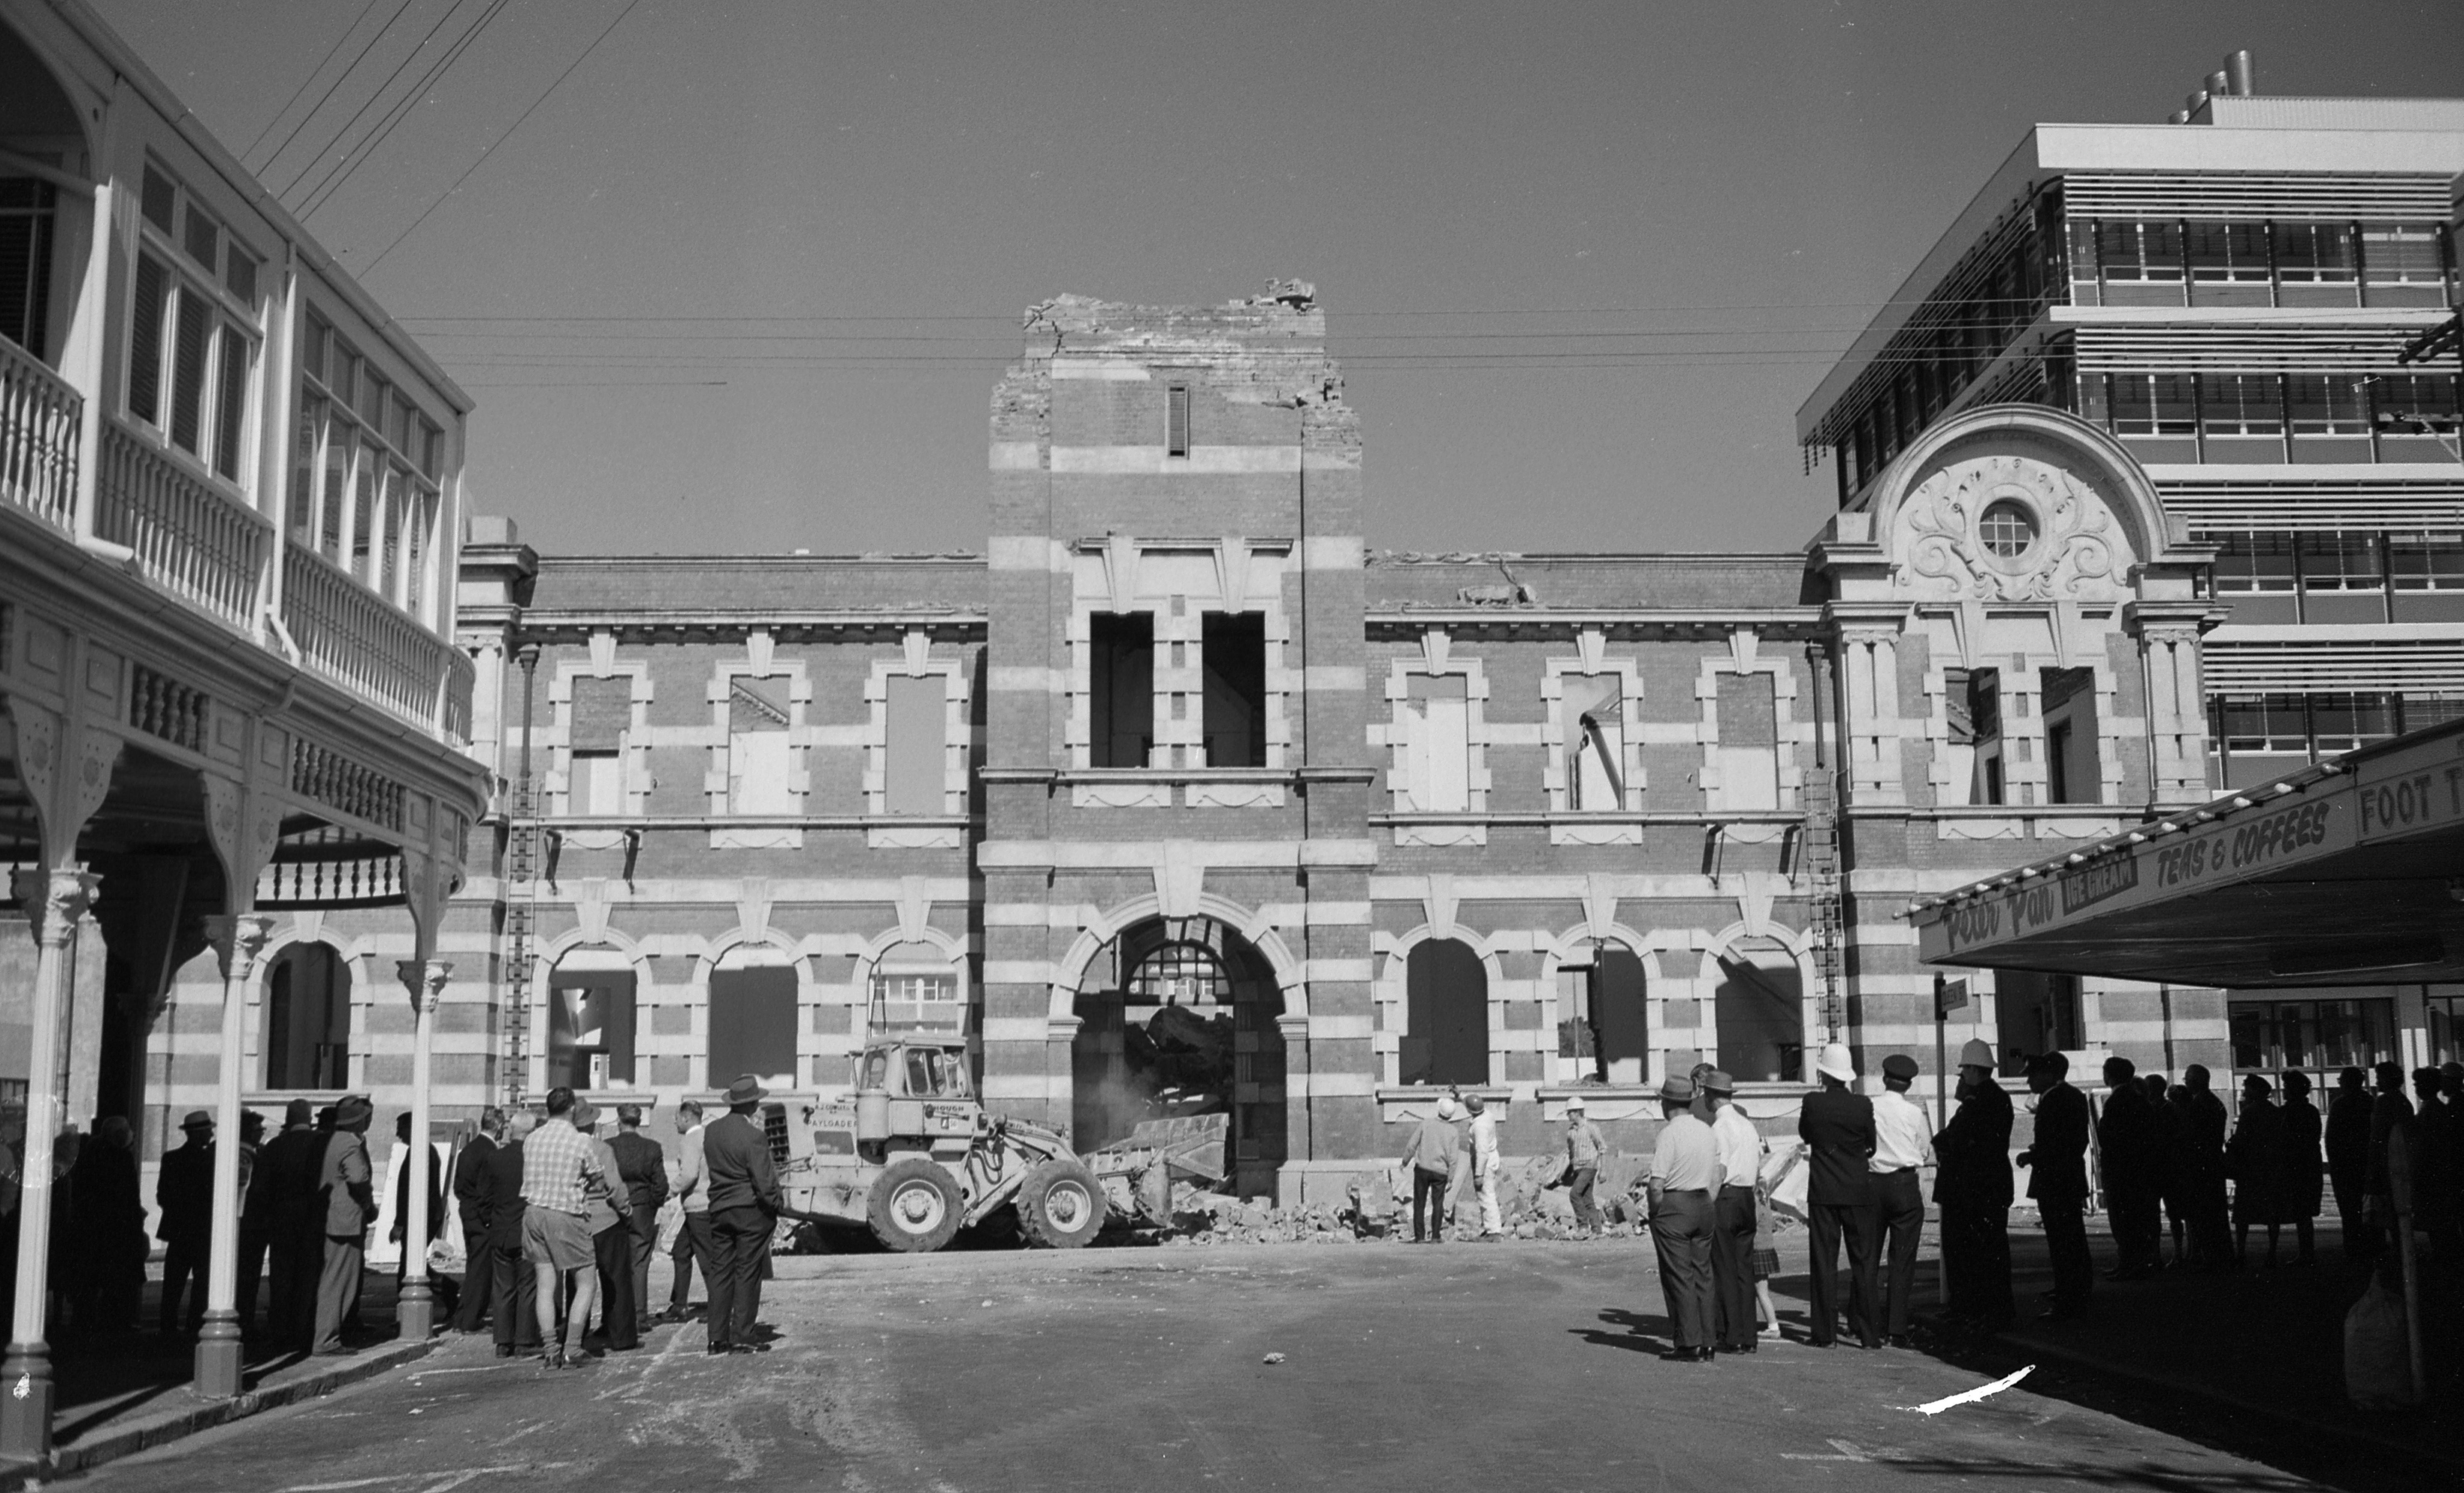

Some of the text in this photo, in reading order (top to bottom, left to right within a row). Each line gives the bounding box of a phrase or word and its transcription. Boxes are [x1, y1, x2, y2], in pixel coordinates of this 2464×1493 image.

[2360, 774, 2432, 835] FOOT
[2157, 802, 2330, 888] TEAS & COFFEES
[2065, 852, 2131, 909] ICE CREAM
[1940, 884, 2053, 954] Peter Pan
